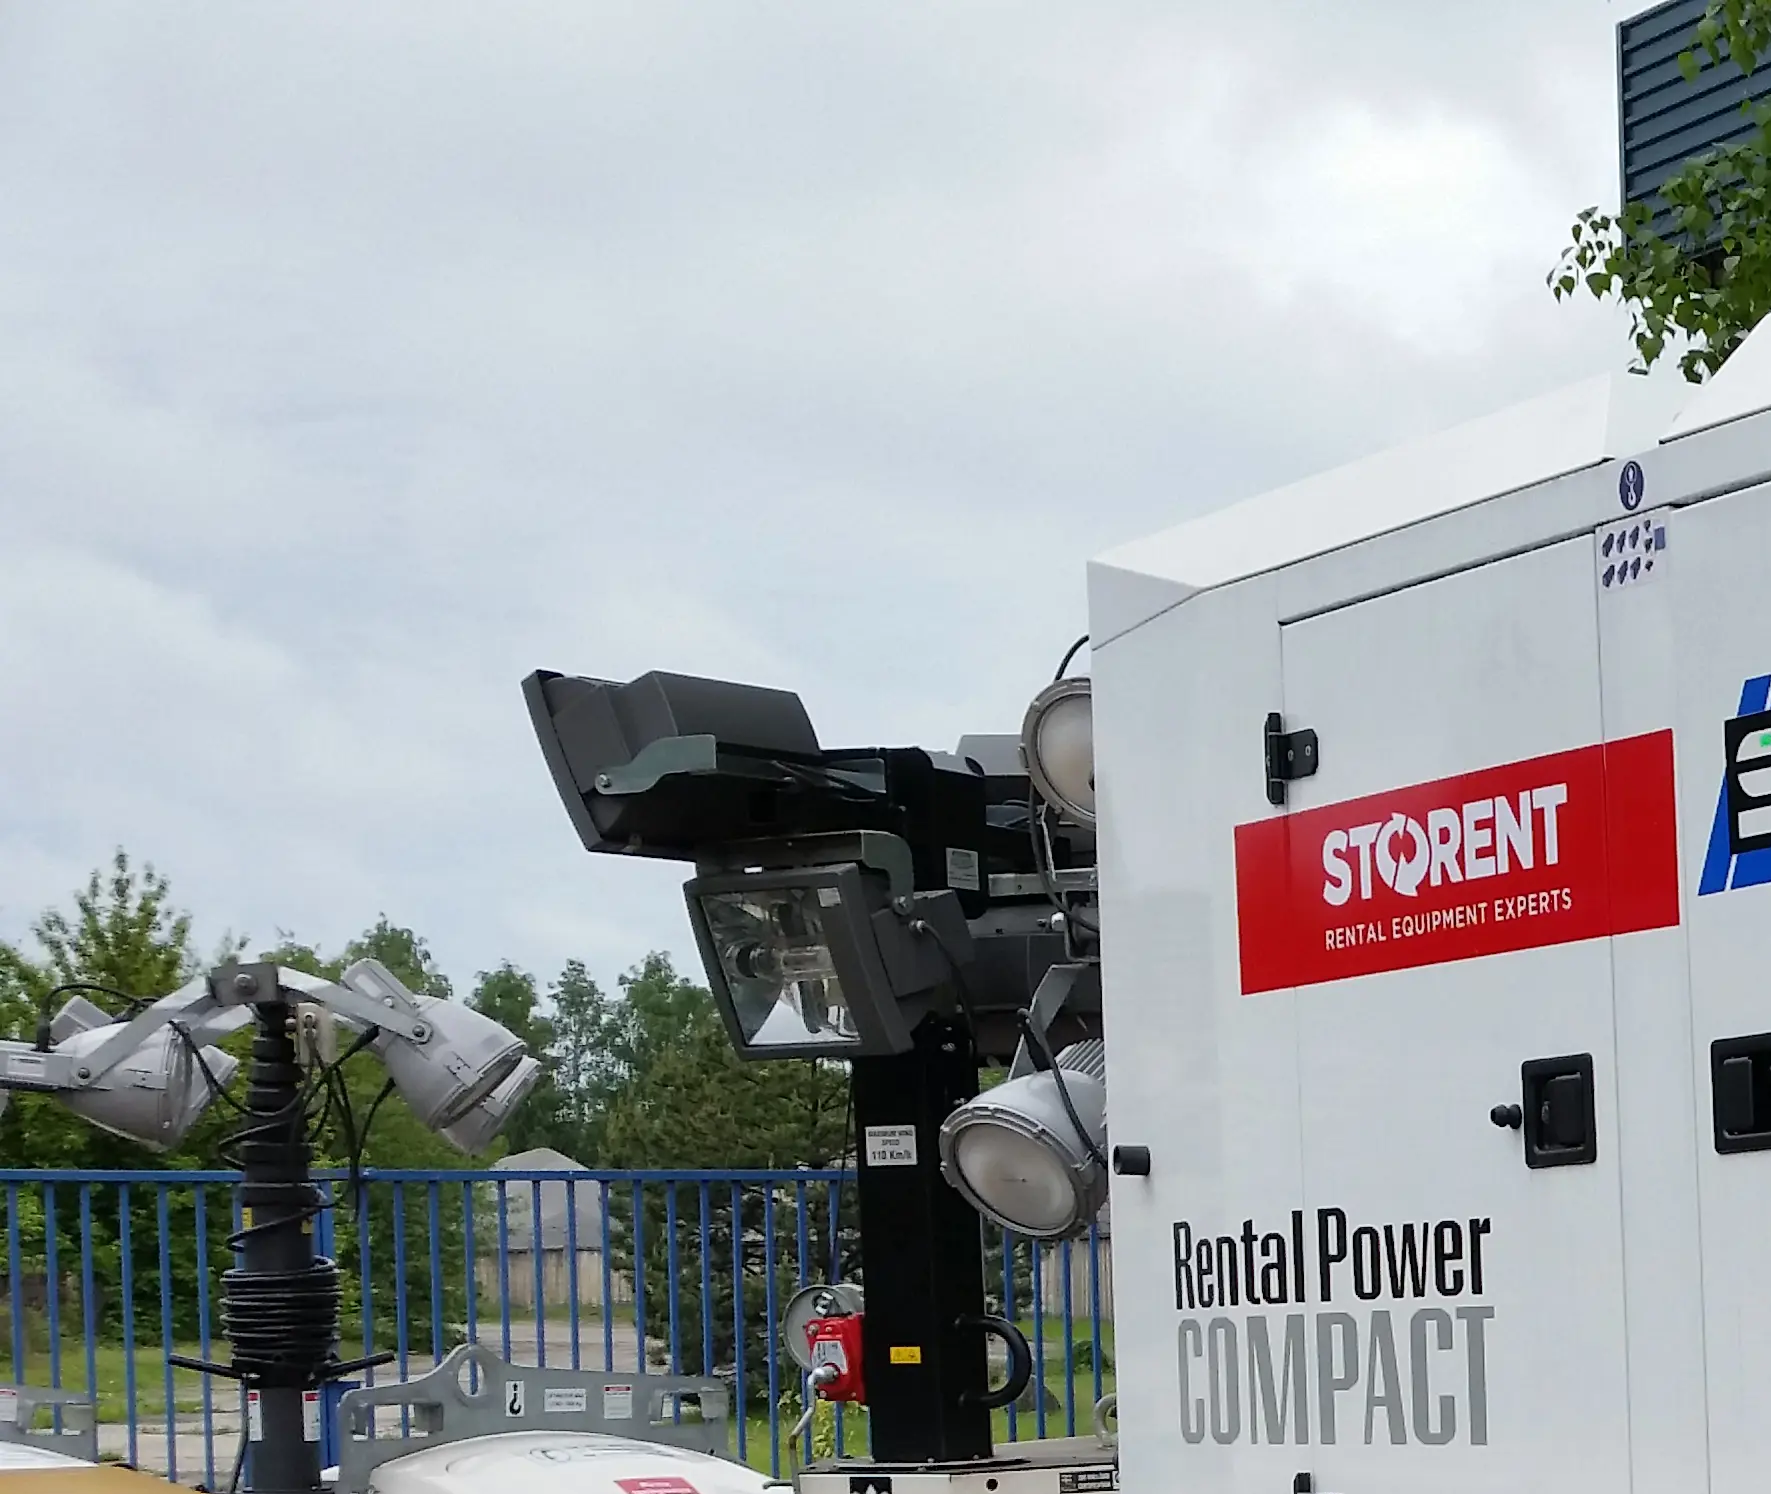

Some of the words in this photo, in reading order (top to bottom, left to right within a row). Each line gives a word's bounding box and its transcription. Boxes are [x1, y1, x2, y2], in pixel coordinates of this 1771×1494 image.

[1322, 782, 1568, 906] STORENT
[1325, 921, 1387, 951] RENTAL
[1391, 901, 1489, 939] EQUIPMENT
[1494, 887, 1573, 921] EXPERTS
[872, 1150, 887, 1160] 110
[1173, 1209, 1306, 1310] Rental
[1317, 1206, 1491, 1302] Power
[1177, 1305, 1496, 1446] COMPACT
